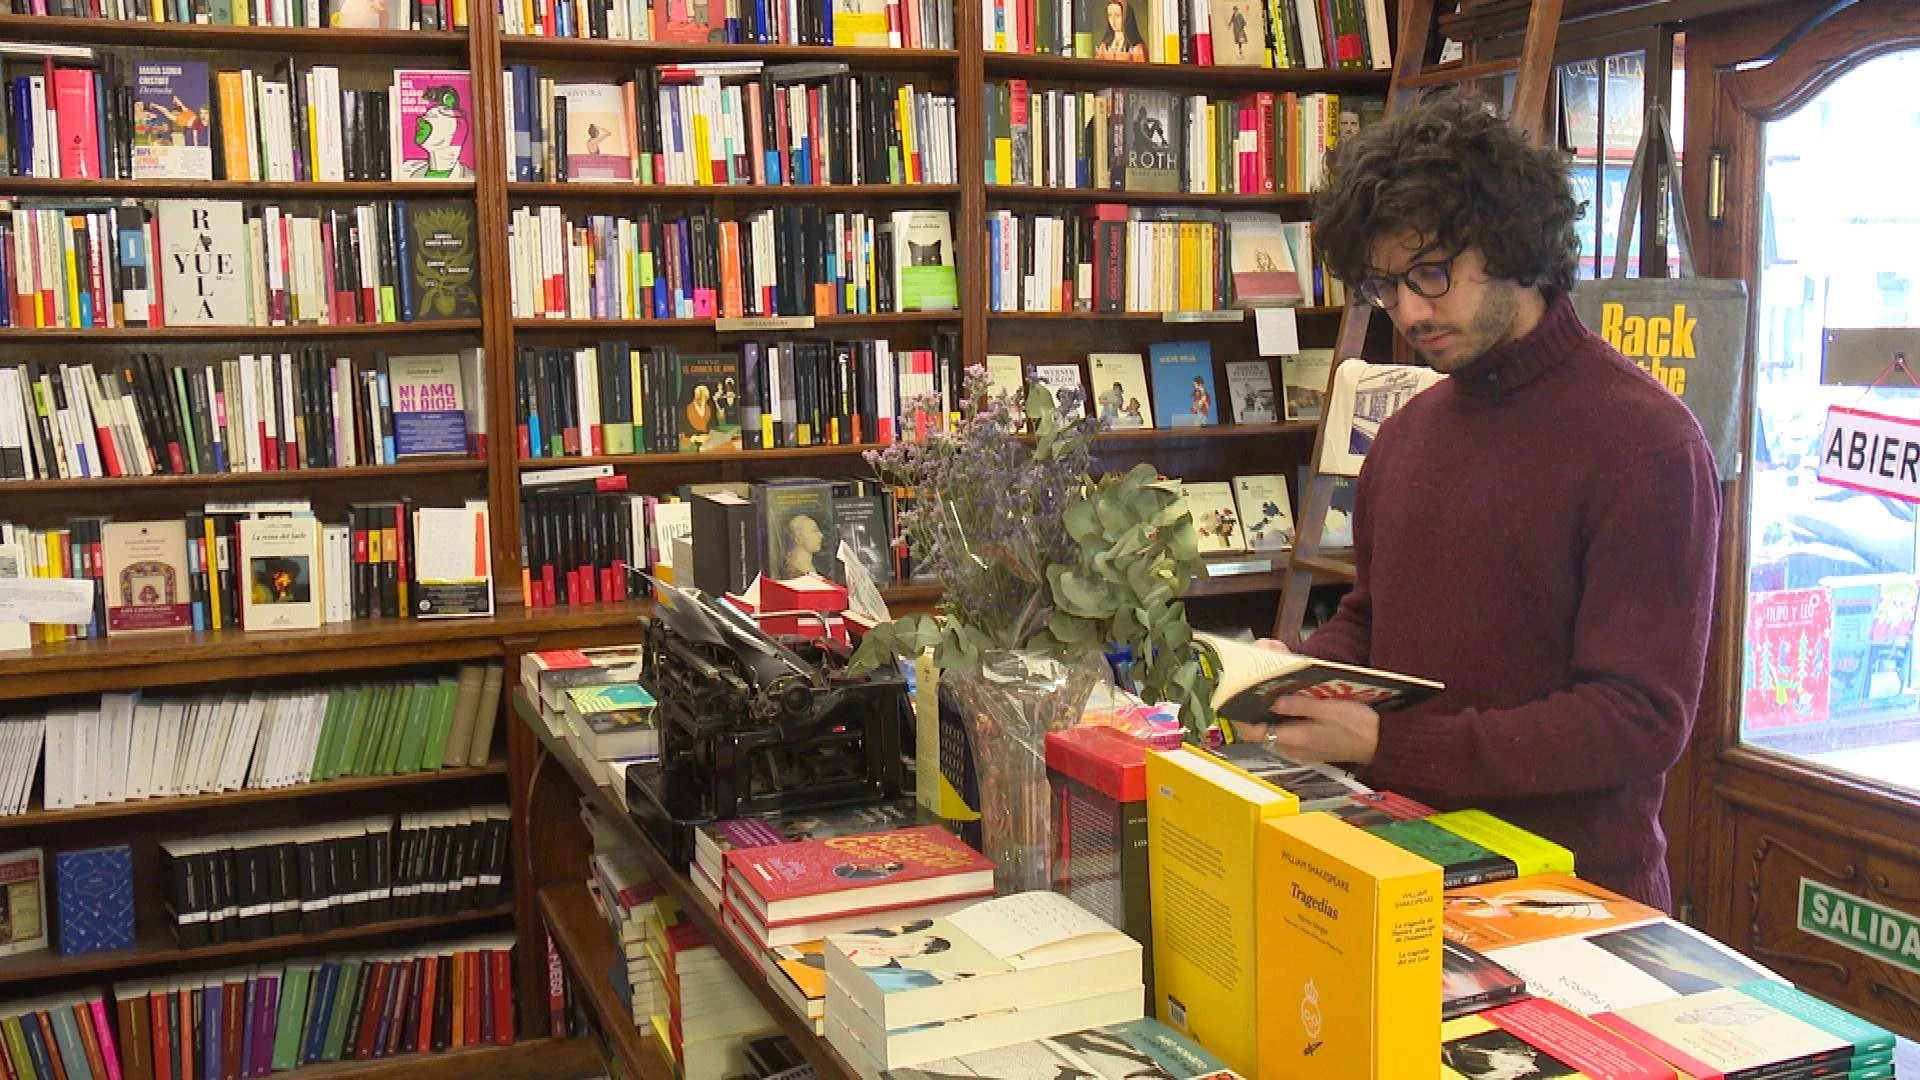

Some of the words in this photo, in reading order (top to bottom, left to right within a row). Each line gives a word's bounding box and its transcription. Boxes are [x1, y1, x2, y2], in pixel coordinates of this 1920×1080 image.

[1128, 151, 1178, 169] ROTH
[399, 385, 416, 399] NI
[420, 383, 456, 397] AMO
[1637, 356, 1687, 396] he
[1825, 427, 1920, 484] ABIER
[1281, 847, 1307, 870] WILLIAM
[1307, 862, 1350, 893] SHAKESPEARE
[1289, 880, 1340, 921] Tragedias
[1811, 892, 1920, 961] SALIDA
